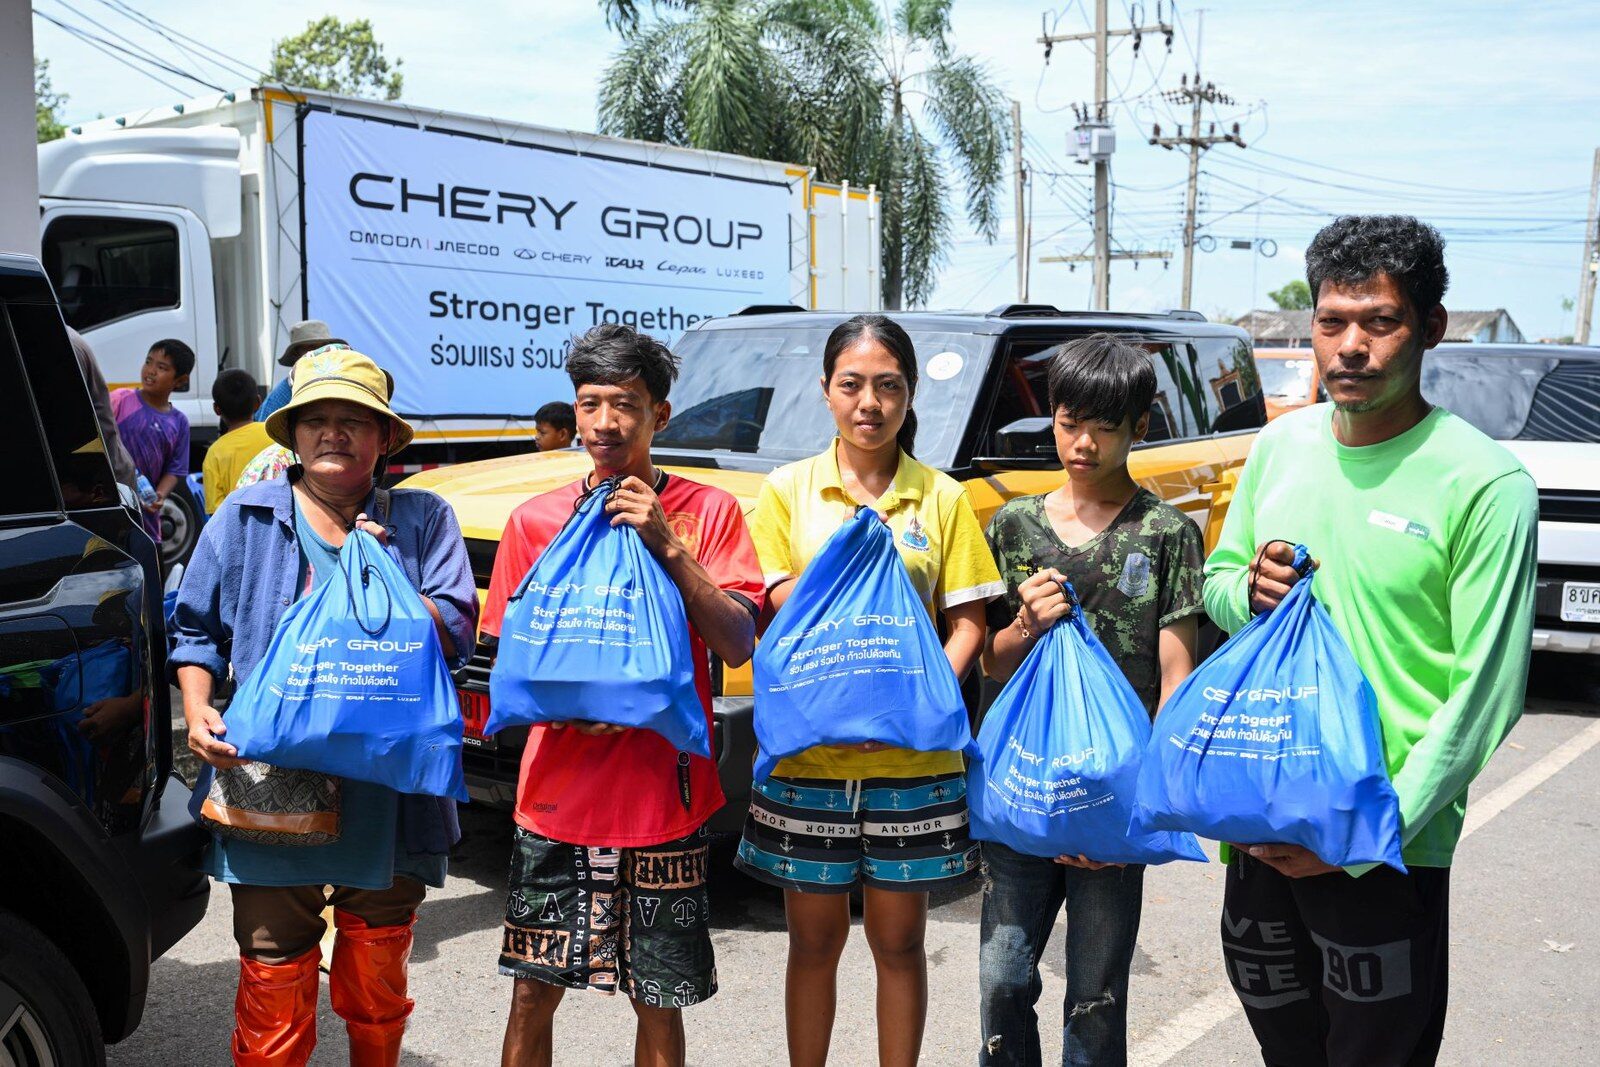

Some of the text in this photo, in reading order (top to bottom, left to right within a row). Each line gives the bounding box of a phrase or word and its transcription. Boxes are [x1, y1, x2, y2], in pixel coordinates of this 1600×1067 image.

[349, 172, 763, 250] CHERY GROUP
[350, 230, 422, 249] OMODA
[434, 240, 500, 256] JAECOO
[541, 251, 593, 264] CHERY
[656, 260, 707, 275] Lepas
[716, 267, 765, 280] LUXEED
[429, 290, 575, 330] Stronger
[430, 335, 515, 368] ร่วมแรง
[346, 638, 424, 653] GROUP
[790, 635, 900, 662] Stronger Together
[339, 661, 399, 674] Together
[462, 738, 482, 748] ECOO
[1052, 746, 1096, 769] ROUP
[805, 823, 858, 836] NCHOR
[881, 819, 943, 835] ANCHOR
[572, 887, 587, 966] ANCHOR
[1223, 904, 1293, 944] VE
[1326, 946, 1384, 998] 90
